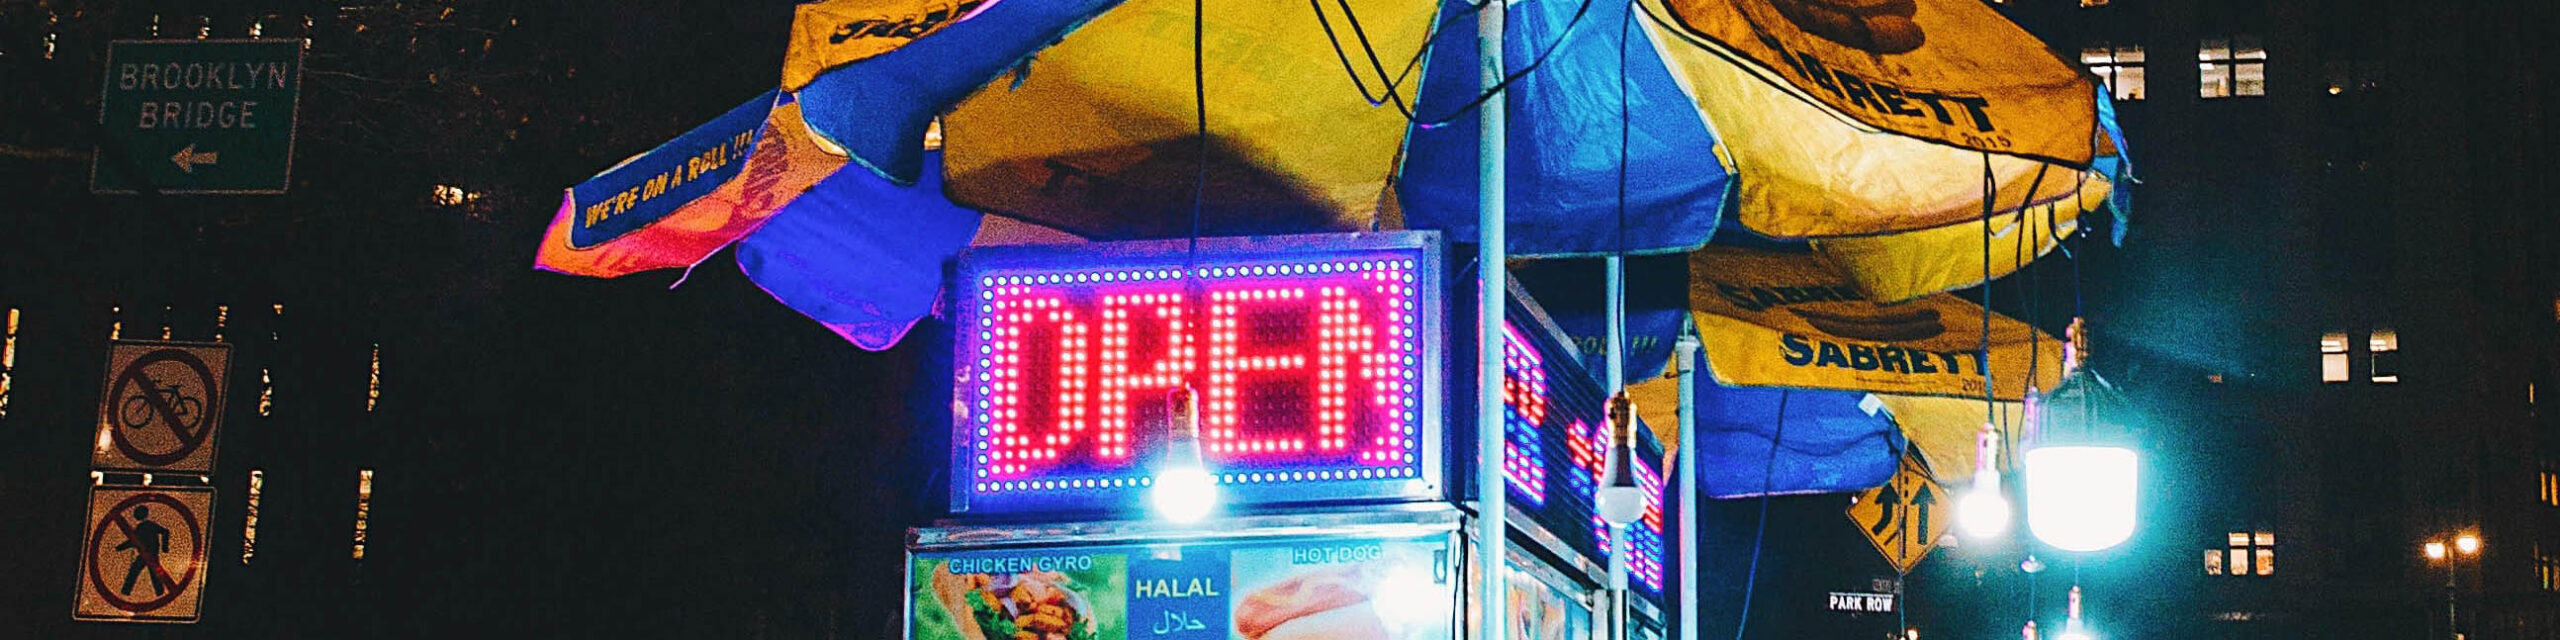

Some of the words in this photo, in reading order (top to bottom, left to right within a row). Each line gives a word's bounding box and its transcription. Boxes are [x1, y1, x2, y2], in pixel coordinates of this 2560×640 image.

[120, 61, 287, 90] BROOKLYN
[139, 101, 258, 128] BRIDGE
[585, 186, 640, 228] WE'RE
[642, 172, 669, 201] ON
[671, 165, 683, 188] A
[688, 142, 727, 181] ROLL
[1780, 333, 1990, 376] SABRETT
[993, 283, 1402, 462] OPEN
[950, 557, 1032, 574] CHICKEN
[1038, 555, 1093, 573] GYRO
[1293, 546, 1335, 564] HOT
[1339, 544, 1382, 563] DOG
[1135, 578, 1219, 599] HALAL
[1829, 595, 1862, 611] PARK
[1866, 597, 1893, 612] ROW
[1153, 611, 1206, 635] حلال
